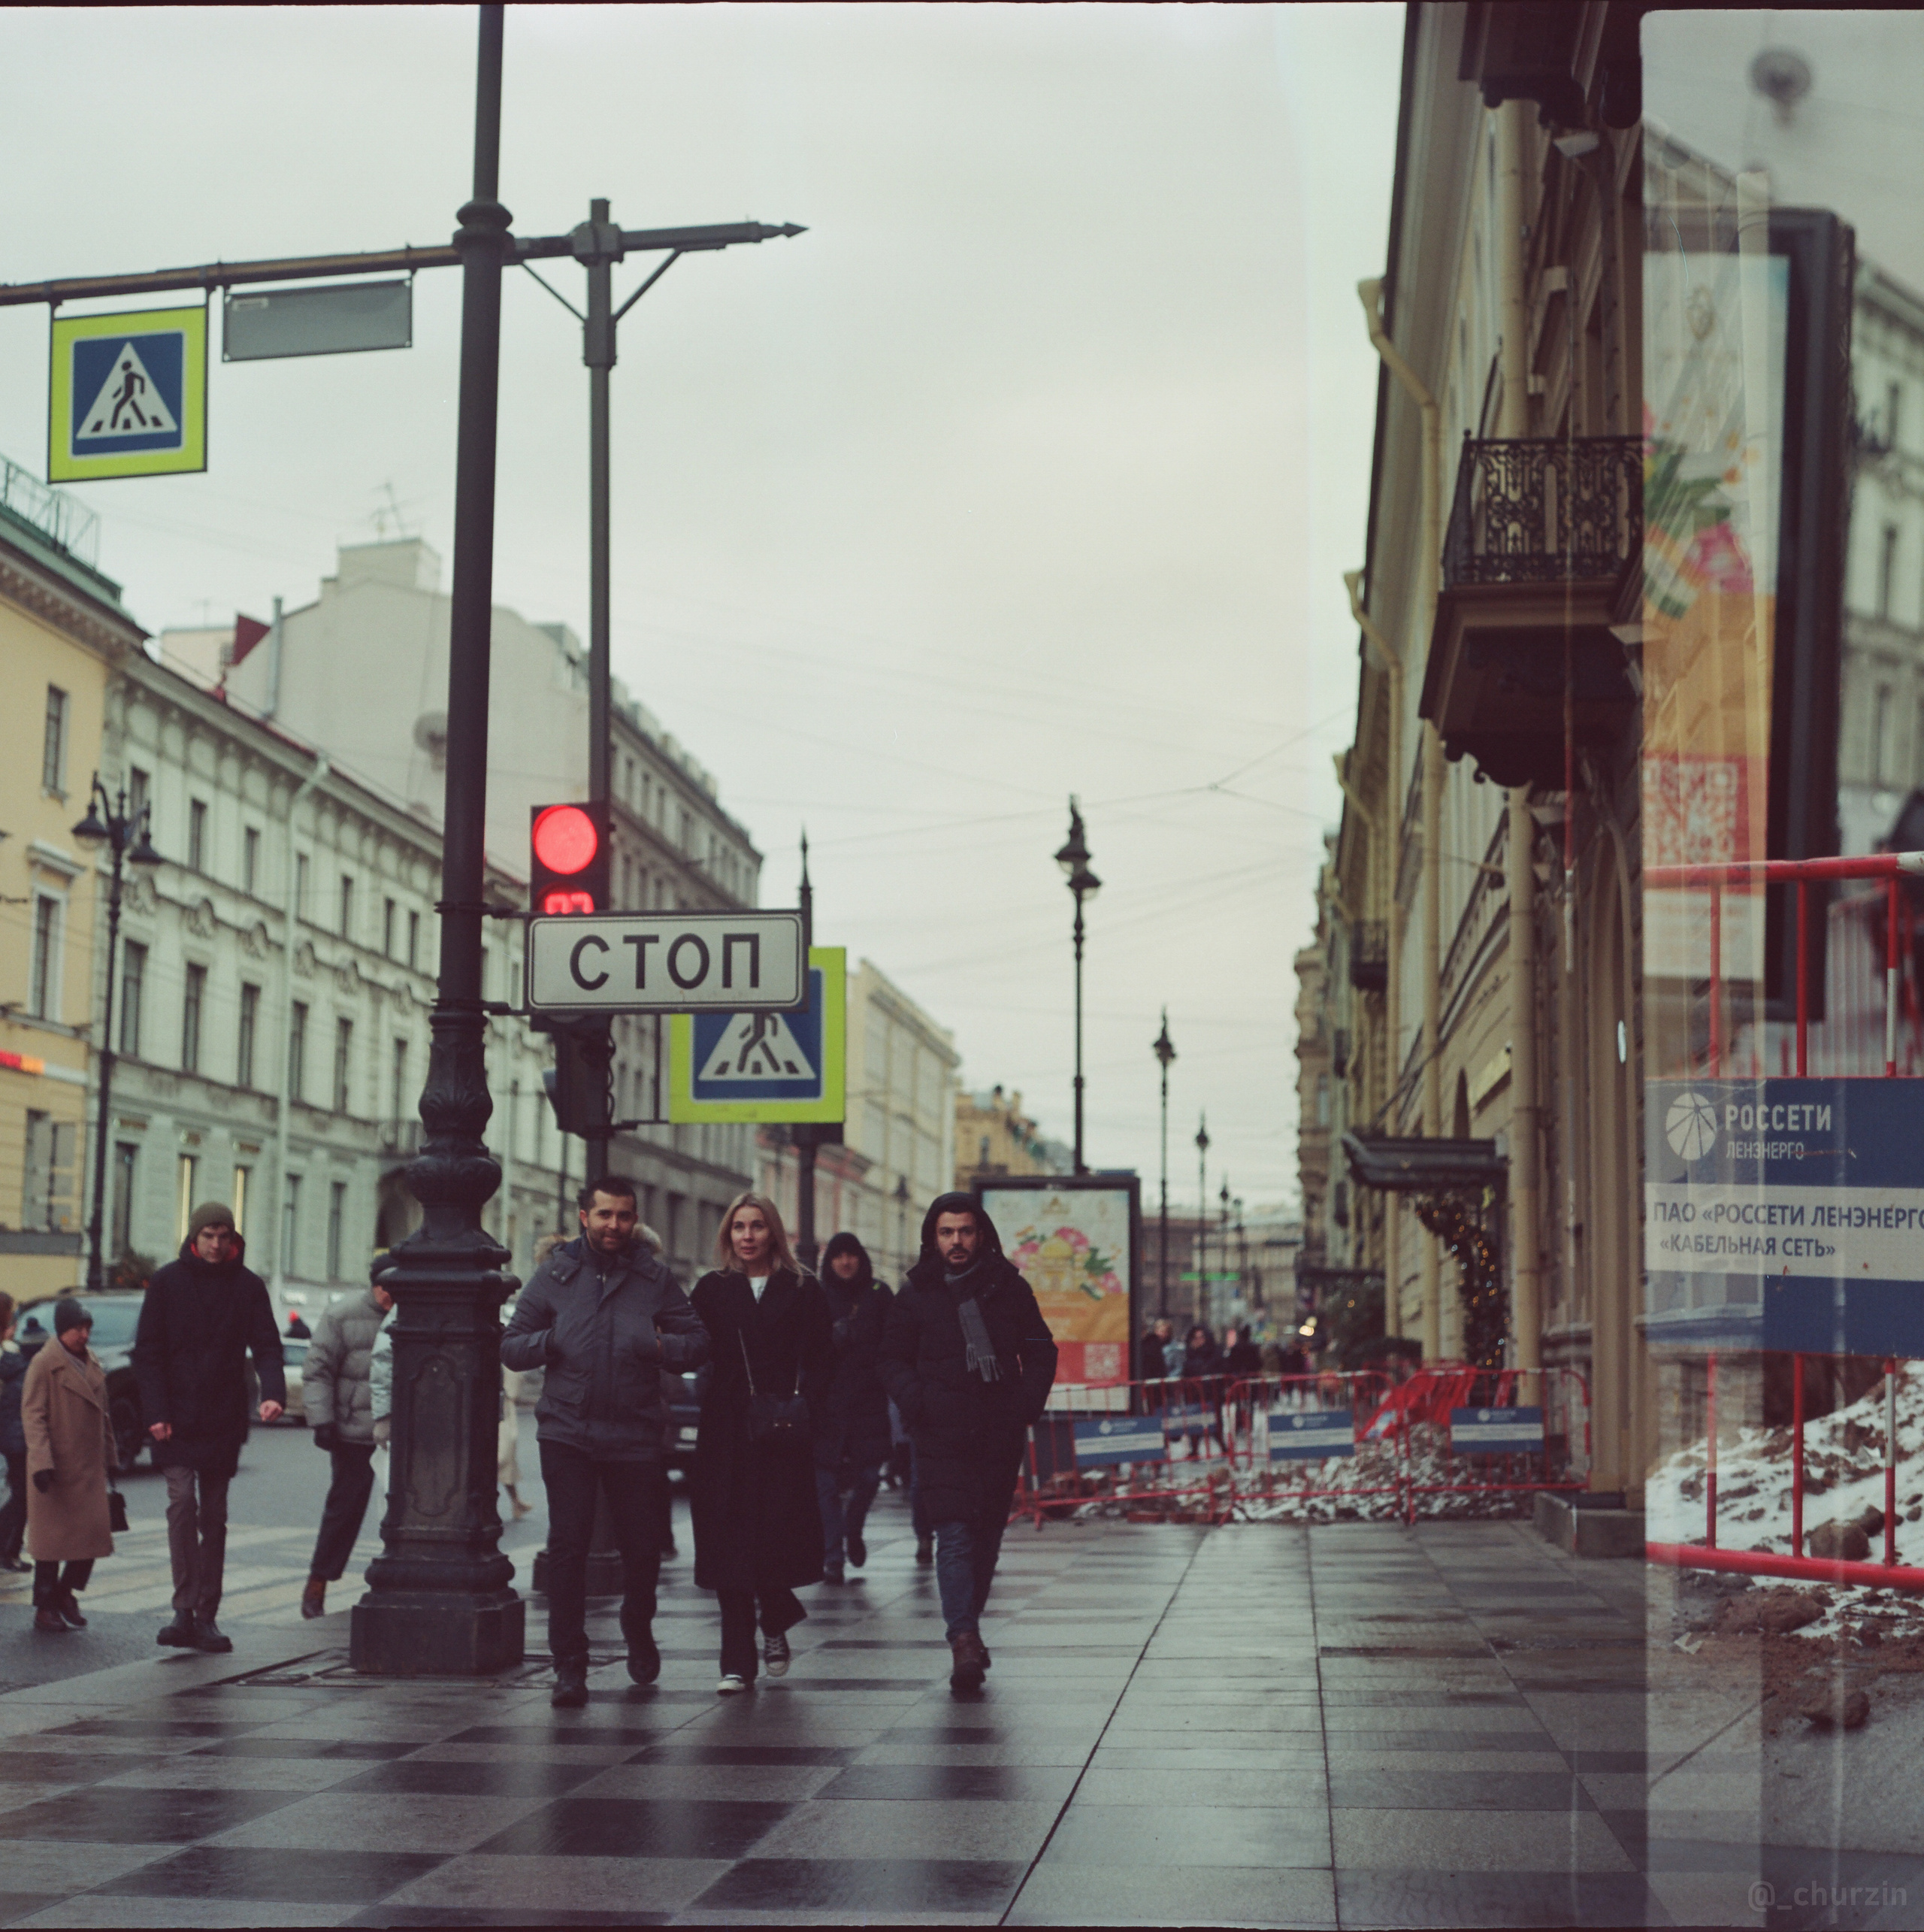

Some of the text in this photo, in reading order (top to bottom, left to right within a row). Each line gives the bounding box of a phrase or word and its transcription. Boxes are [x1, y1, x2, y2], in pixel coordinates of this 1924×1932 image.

[569, 933, 760, 991] СТОП
[1726, 1104, 1832, 1131] РОССЕТИ
[1726, 1140, 1805, 1160] ЛЕНЭНЕРГО
[1653, 1202, 1696, 1223] ПАО
[1702, 1204, 1805, 1226] «РОССЕТИ
[1659, 1234, 1835, 1257] «КАБЕЛЬНАЯ СЕТЬ»
